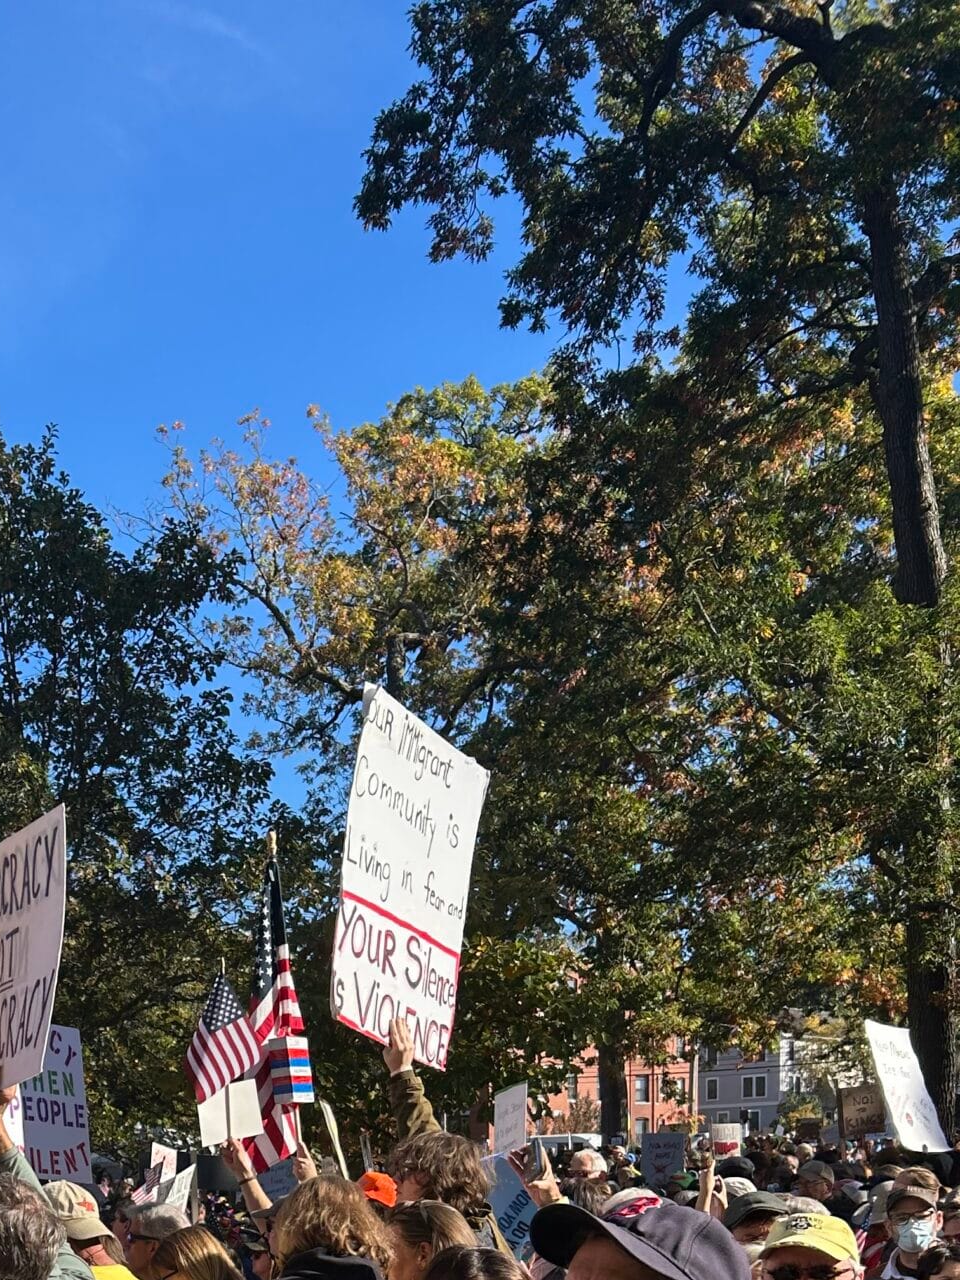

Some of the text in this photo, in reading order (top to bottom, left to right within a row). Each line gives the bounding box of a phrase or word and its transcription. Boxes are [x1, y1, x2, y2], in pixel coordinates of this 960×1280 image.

[446, 812, 460, 849] is
[346, 825, 464, 920] Living in fear and
[338, 901, 455, 1008] YOUR Silence
[18, 1070, 76, 1098] HEN
[9, 1095, 87, 1129] PEOPLE
[17, 1142, 90, 1175] ILENT
